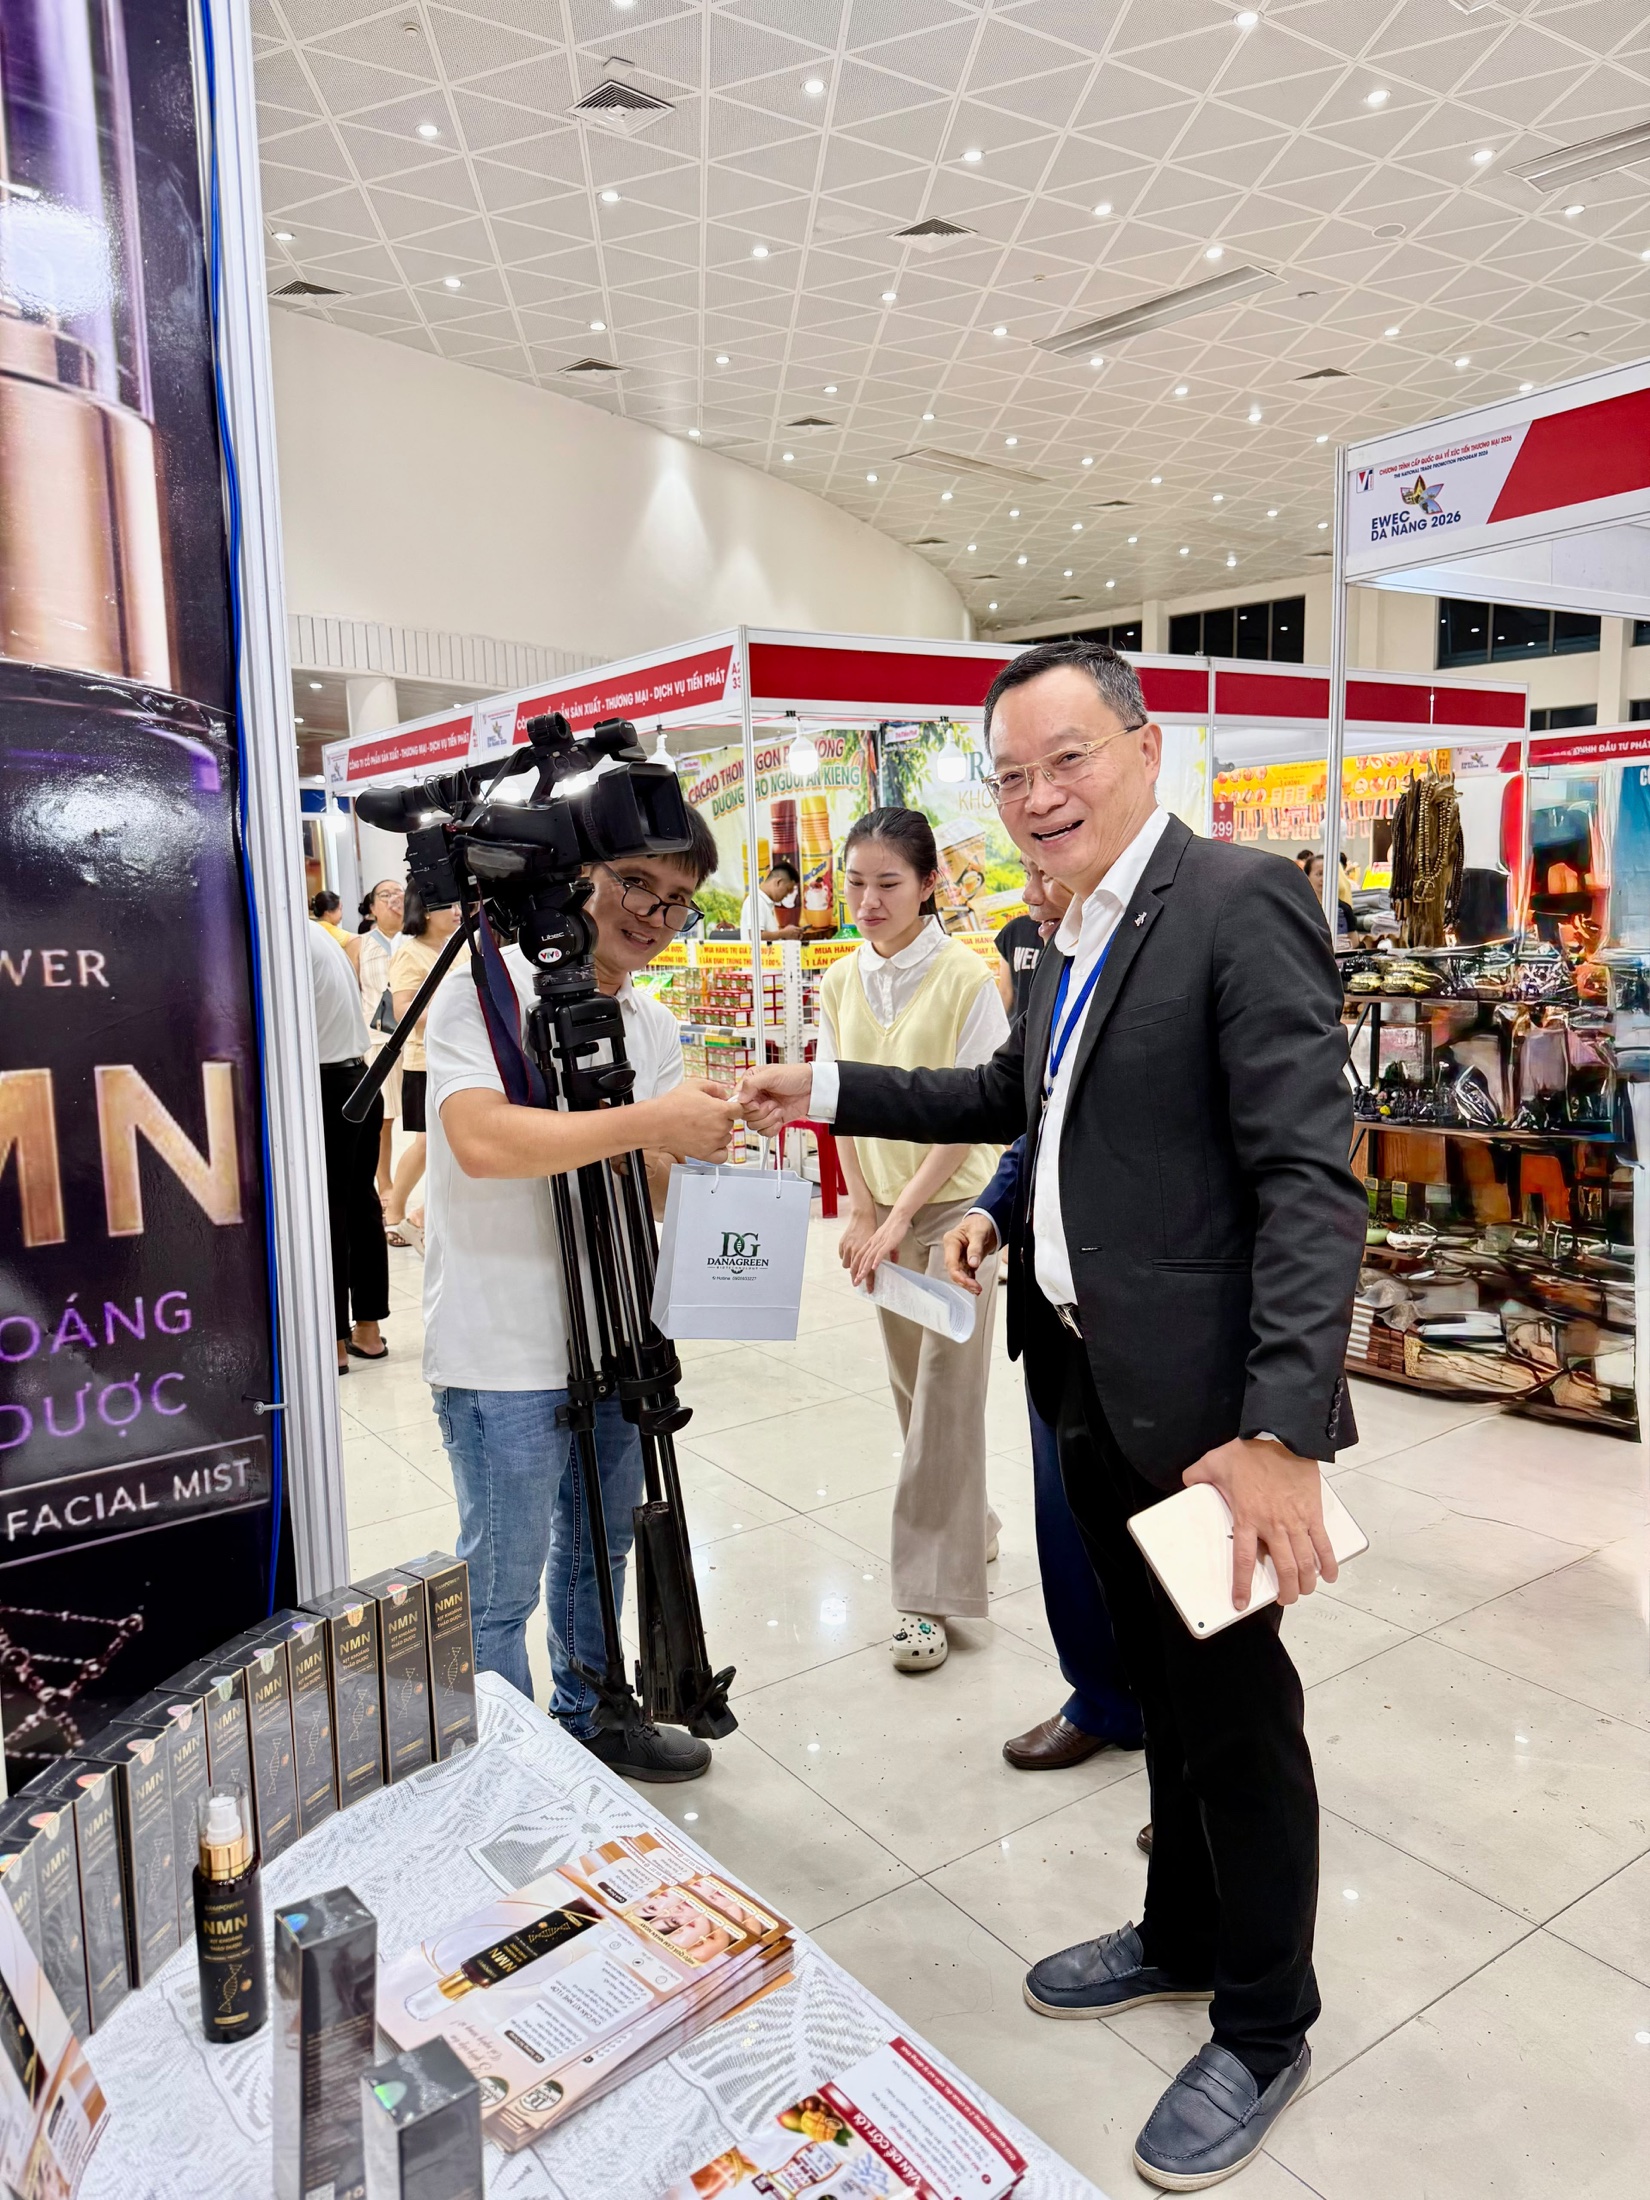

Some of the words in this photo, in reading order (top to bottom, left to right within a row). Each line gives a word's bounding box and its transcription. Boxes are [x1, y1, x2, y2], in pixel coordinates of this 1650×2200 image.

[1371, 510, 1410, 530] EWEC
[1371, 527, 1388, 542] DA
[1391, 519, 1427, 537] NANG
[1431, 510, 1461, 528] 2026
[570, 699, 584, 719] SẢN
[584, 696, 601, 715] XUẤT
[605, 691, 634, 709] THƯƠNG
[634, 689, 649, 707] MẠI
[653, 681, 673, 703] DỊCH
[673, 680, 686, 700] VỤ
[686, 670, 703, 692] TIẾN
[704, 666, 726, 688] PHÁT
[688, 774, 720, 805] CACAO
[1212, 821, 1233, 838] 299
[707, 1257, 769, 1267] DANAGREEN
[7, 1482, 159, 1542] FACIAL
[173, 1456, 253, 1501] MIST
[434, 1591, 464, 1614] NMN
[388, 1610, 418, 1635] NMN
[339, 1631, 372, 1657] NMN
[295, 1650, 323, 1678] NMN
[255, 1675, 283, 1705] NMN
[213, 1703, 241, 1733] NMN
[173, 1734, 200, 1768] NMN
[135, 1768, 164, 1803] NMN
[84, 1805, 114, 1842] NMN
[41, 1843, 71, 1884] NMN
[203, 1913, 249, 1935] NMN
[488, 1947, 517, 1973] NMN
[850, 2110, 872, 2132] LÕI
[863, 2125, 891, 2153] CỐT
[882, 2144, 904, 2166] ĐỀ
[895, 2159, 923, 2187] VẤN
